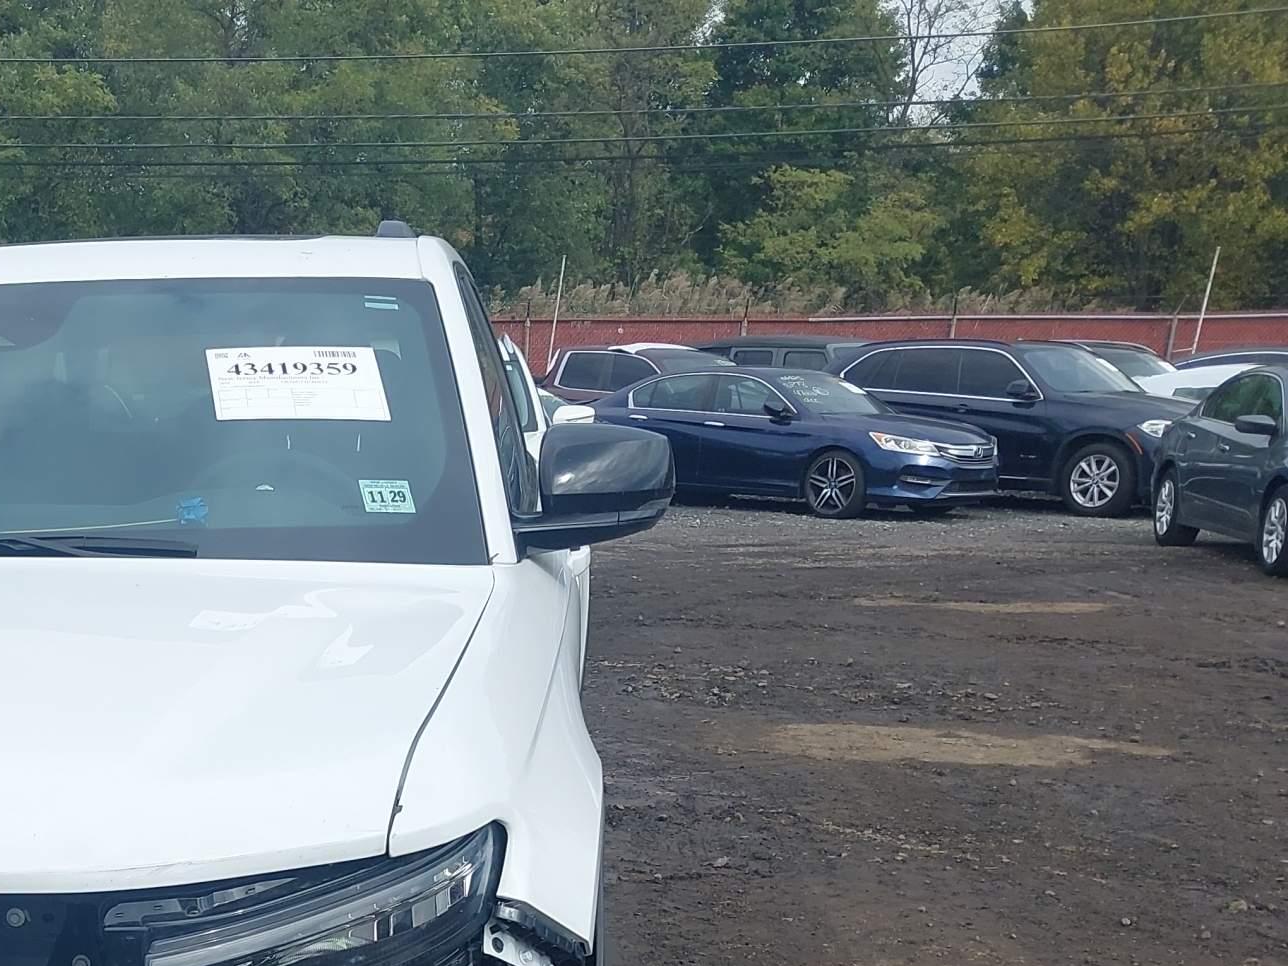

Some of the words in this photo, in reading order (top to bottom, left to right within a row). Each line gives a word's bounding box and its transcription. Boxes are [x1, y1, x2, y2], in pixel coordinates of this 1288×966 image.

[226, 361, 358, 376] 43419359
[367, 490, 387, 503] 11
[388, 490, 407, 503] 29
